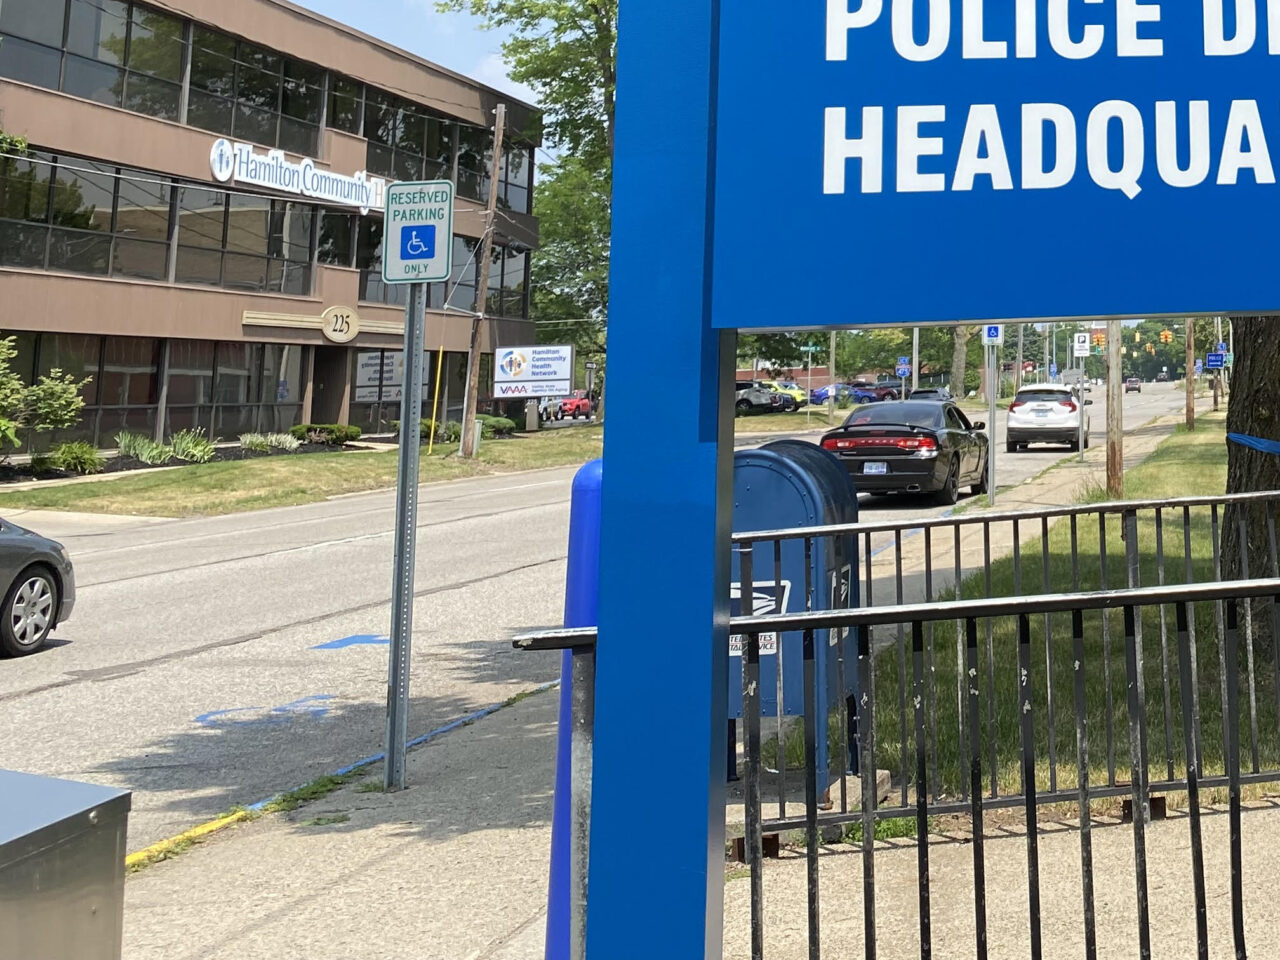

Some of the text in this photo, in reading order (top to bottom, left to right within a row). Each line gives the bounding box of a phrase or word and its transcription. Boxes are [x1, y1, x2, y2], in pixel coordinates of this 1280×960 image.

[237, 147, 300, 189] Hamilton
[303, 163, 373, 209] Community
[391, 190, 449, 205] RESERVED
[393, 207, 445, 222] PARKING
[404, 263, 429, 274] ONLY
[332, 314, 350, 335] 225
